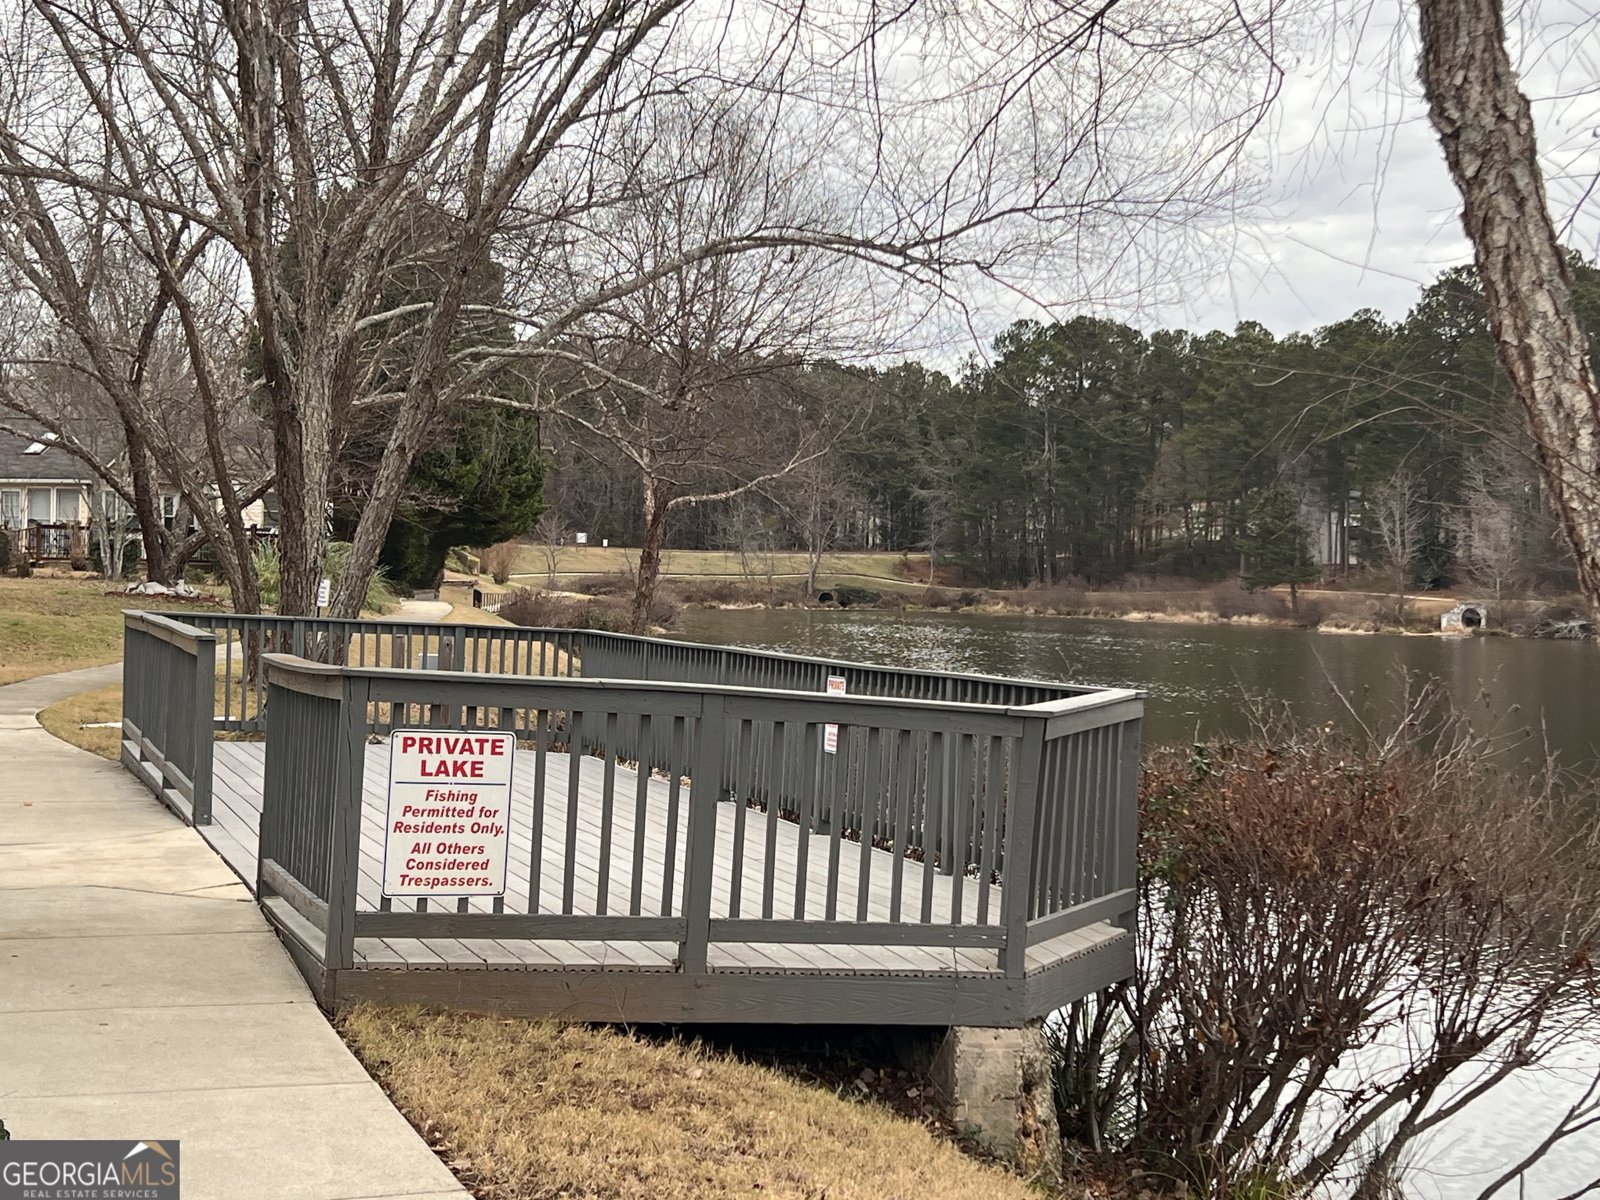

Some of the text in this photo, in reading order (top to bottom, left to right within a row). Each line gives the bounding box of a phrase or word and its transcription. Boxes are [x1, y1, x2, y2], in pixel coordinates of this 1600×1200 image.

[402, 736, 505, 756] PRIVATE
[420, 760, 484, 778] LAKE
[425, 790, 478, 805] Fishing
[402, 806, 499, 819] Permitted for
[393, 821, 505, 837] Residents Only.
[411, 842, 485, 855] All Others
[406, 858, 490, 871] Considered
[400, 874, 493, 889] Trespassers.
